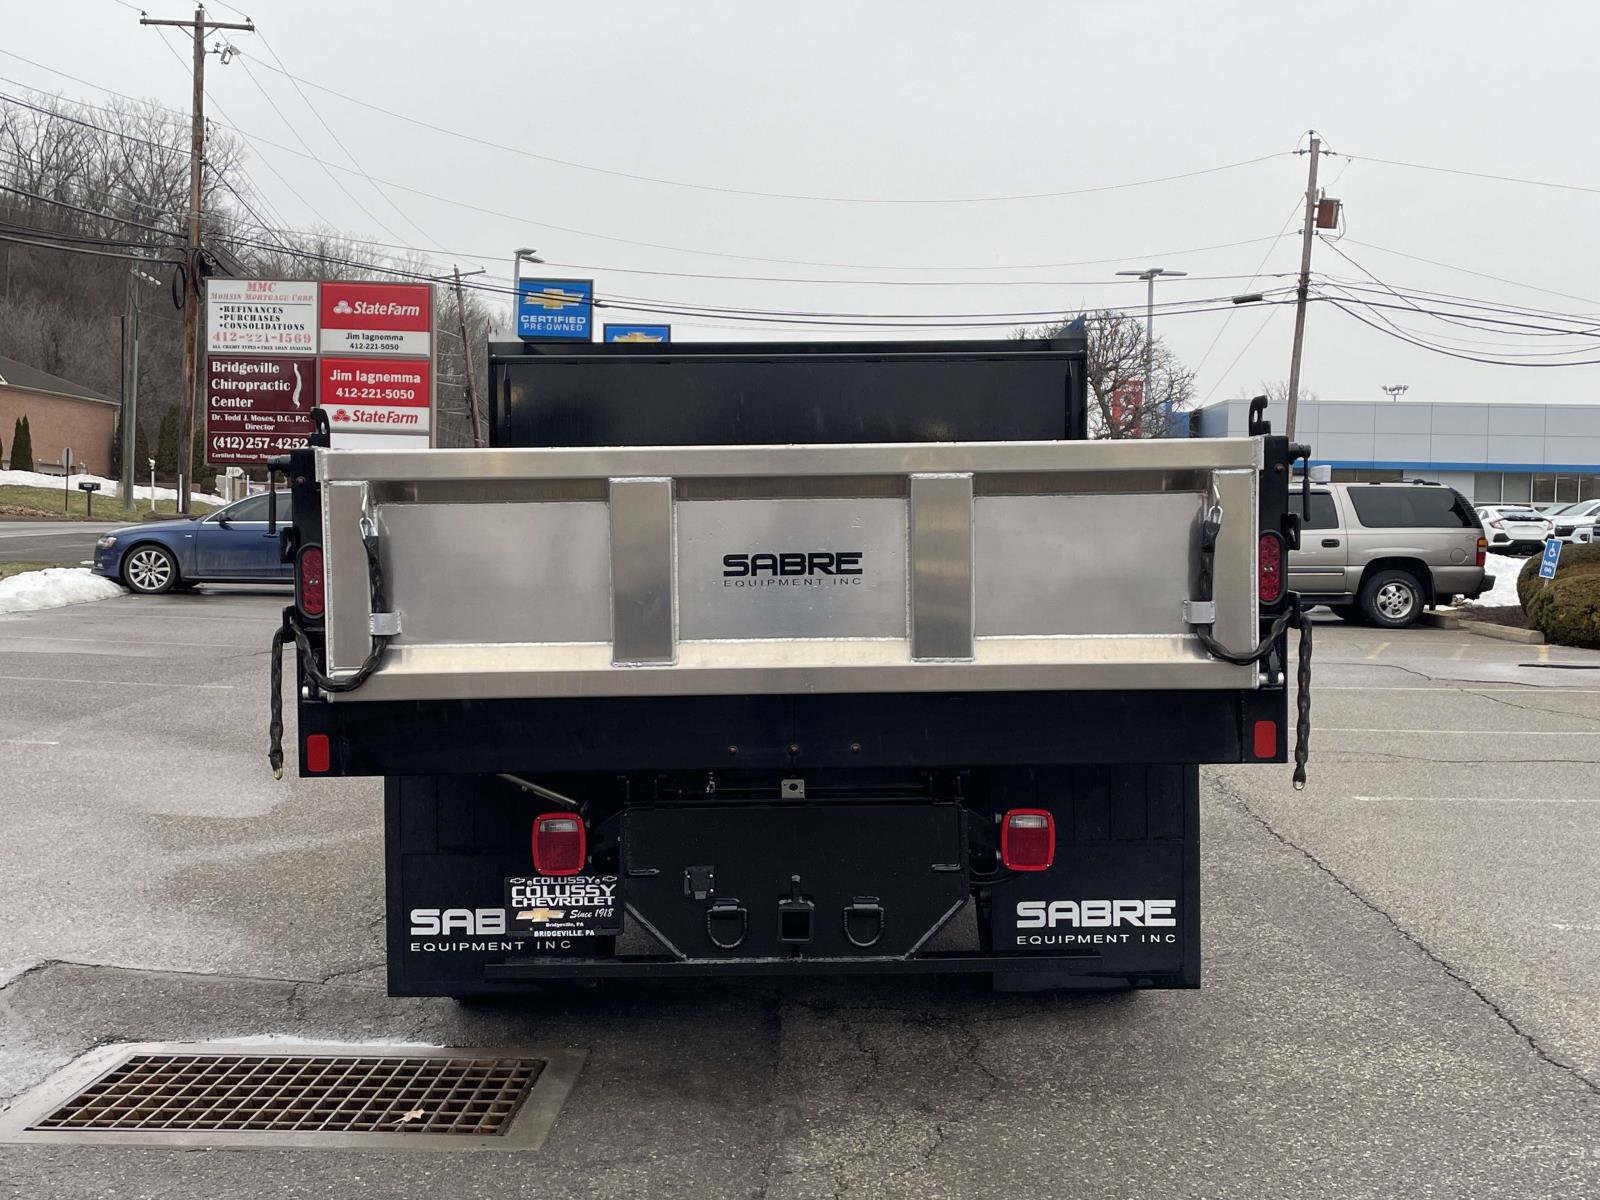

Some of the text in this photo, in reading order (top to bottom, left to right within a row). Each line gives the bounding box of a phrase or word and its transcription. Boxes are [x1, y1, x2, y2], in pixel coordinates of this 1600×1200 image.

[246, 282, 277, 292] MMC
[520, 314, 586, 324] CERTIFIED
[224, 322, 305, 330] CONSOLIDATIONS
[212, 361, 280, 375] Bridgeville
[330, 370, 352, 381] Jim
[212, 378, 290, 392] Chiropractic
[336, 388, 415, 400] 412-221-5050
[212, 396, 254, 408] Center
[213, 436, 309, 450] (412) 257-4252
[723, 552, 863, 577] SABRE
[724, 578, 824, 588] EQUIPMENT
[533, 876, 596, 885] COLUSSY
[511, 884, 617, 898] COLUSSY
[512, 896, 616, 907] CHEVROLET
[570, 908, 614, 919] Since 1918
[1016, 900, 1176, 928] SABRE
[410, 908, 505, 936] SAB
[1016, 934, 1176, 945] EQUIPMENT INC
[410, 940, 572, 952] EQUIPMENT INC
